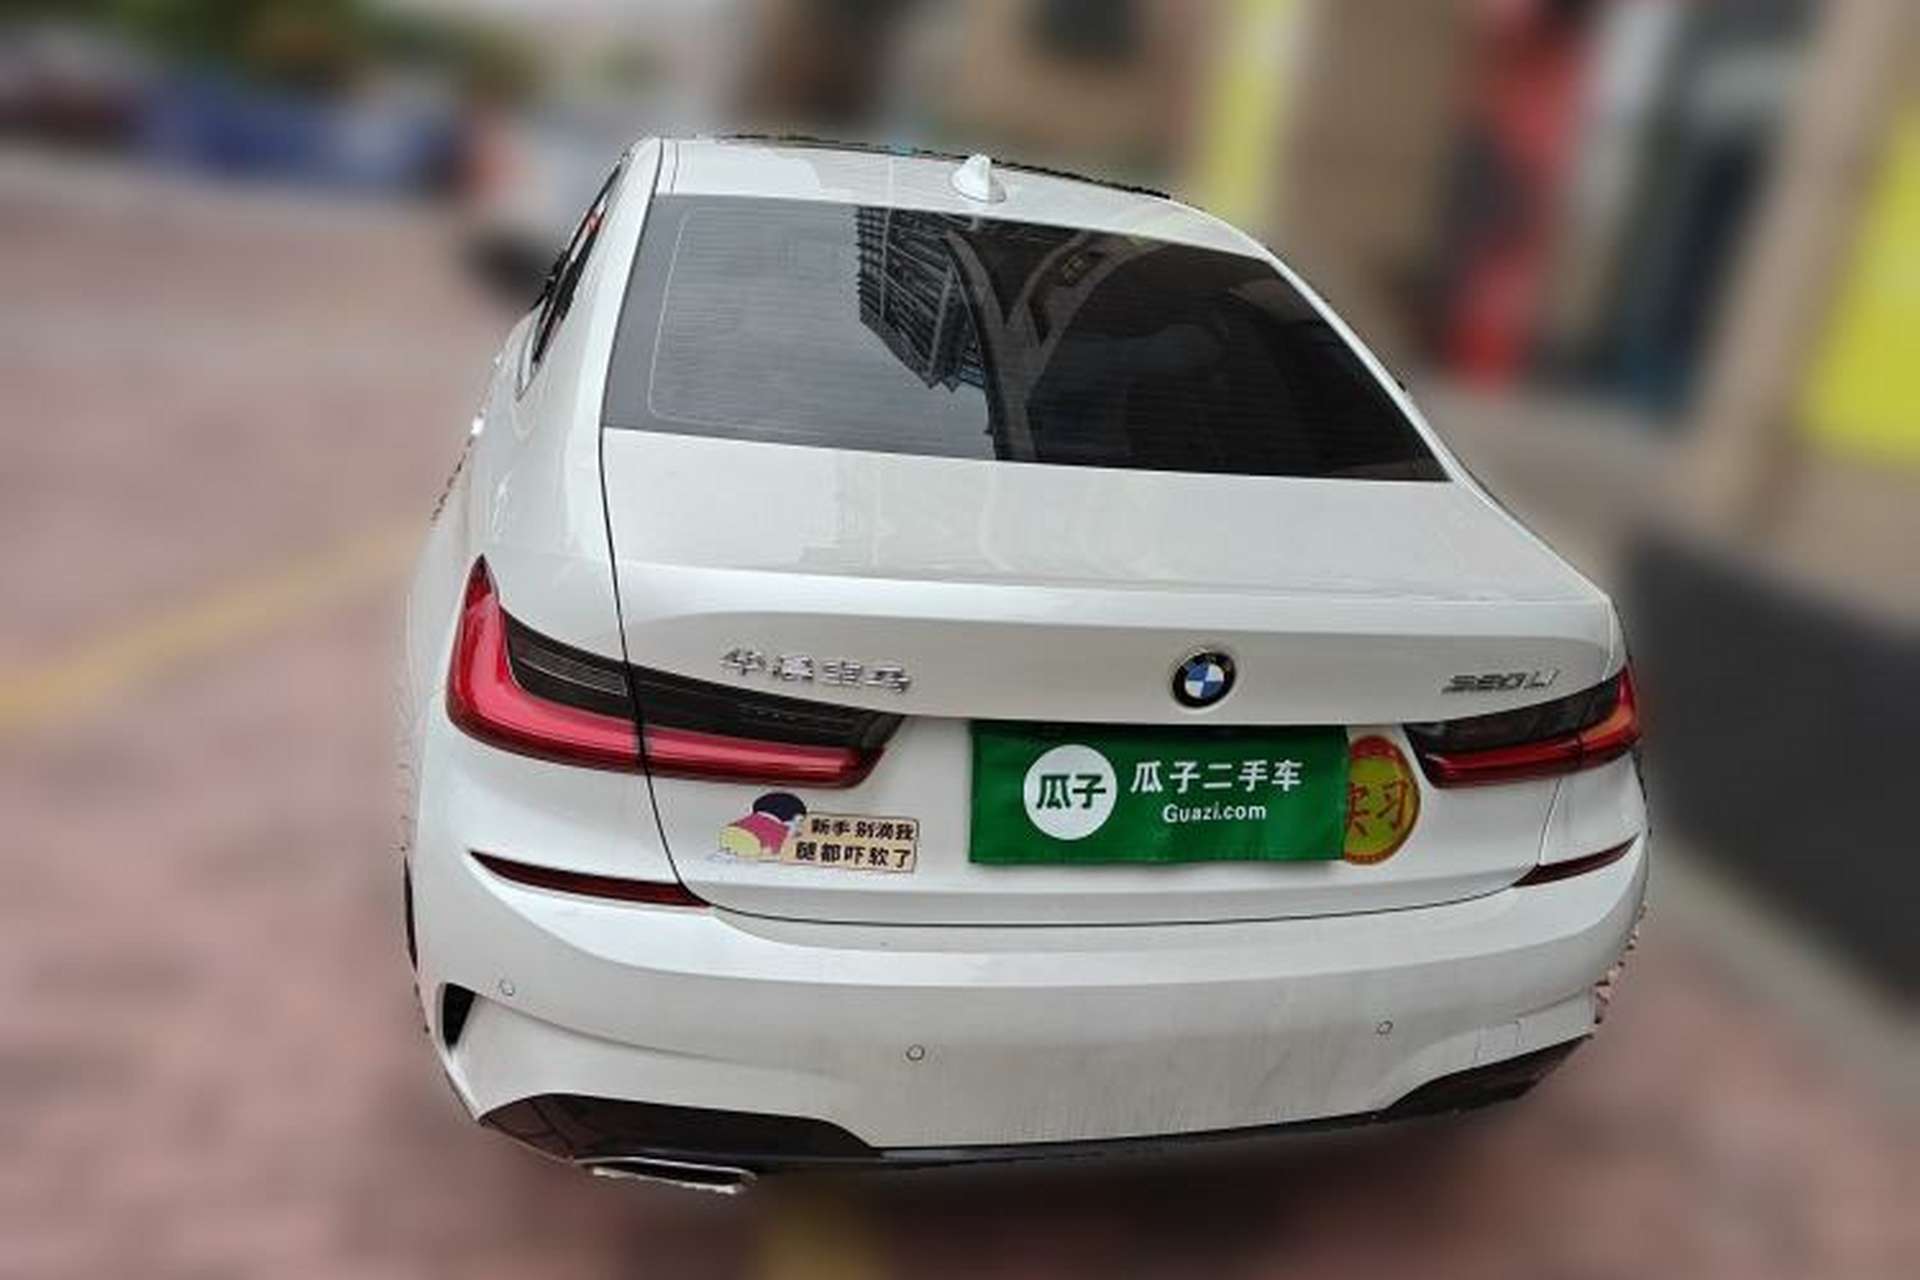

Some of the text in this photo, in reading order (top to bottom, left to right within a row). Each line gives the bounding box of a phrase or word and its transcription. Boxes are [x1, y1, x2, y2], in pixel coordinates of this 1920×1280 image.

[1036, 773, 1106, 809] 瓜子
[1130, 759, 1302, 793] 瓜子二手车
[1162, 803, 1267, 824] Guazi.com
[796, 841, 911, 868] 腿都吓软了
